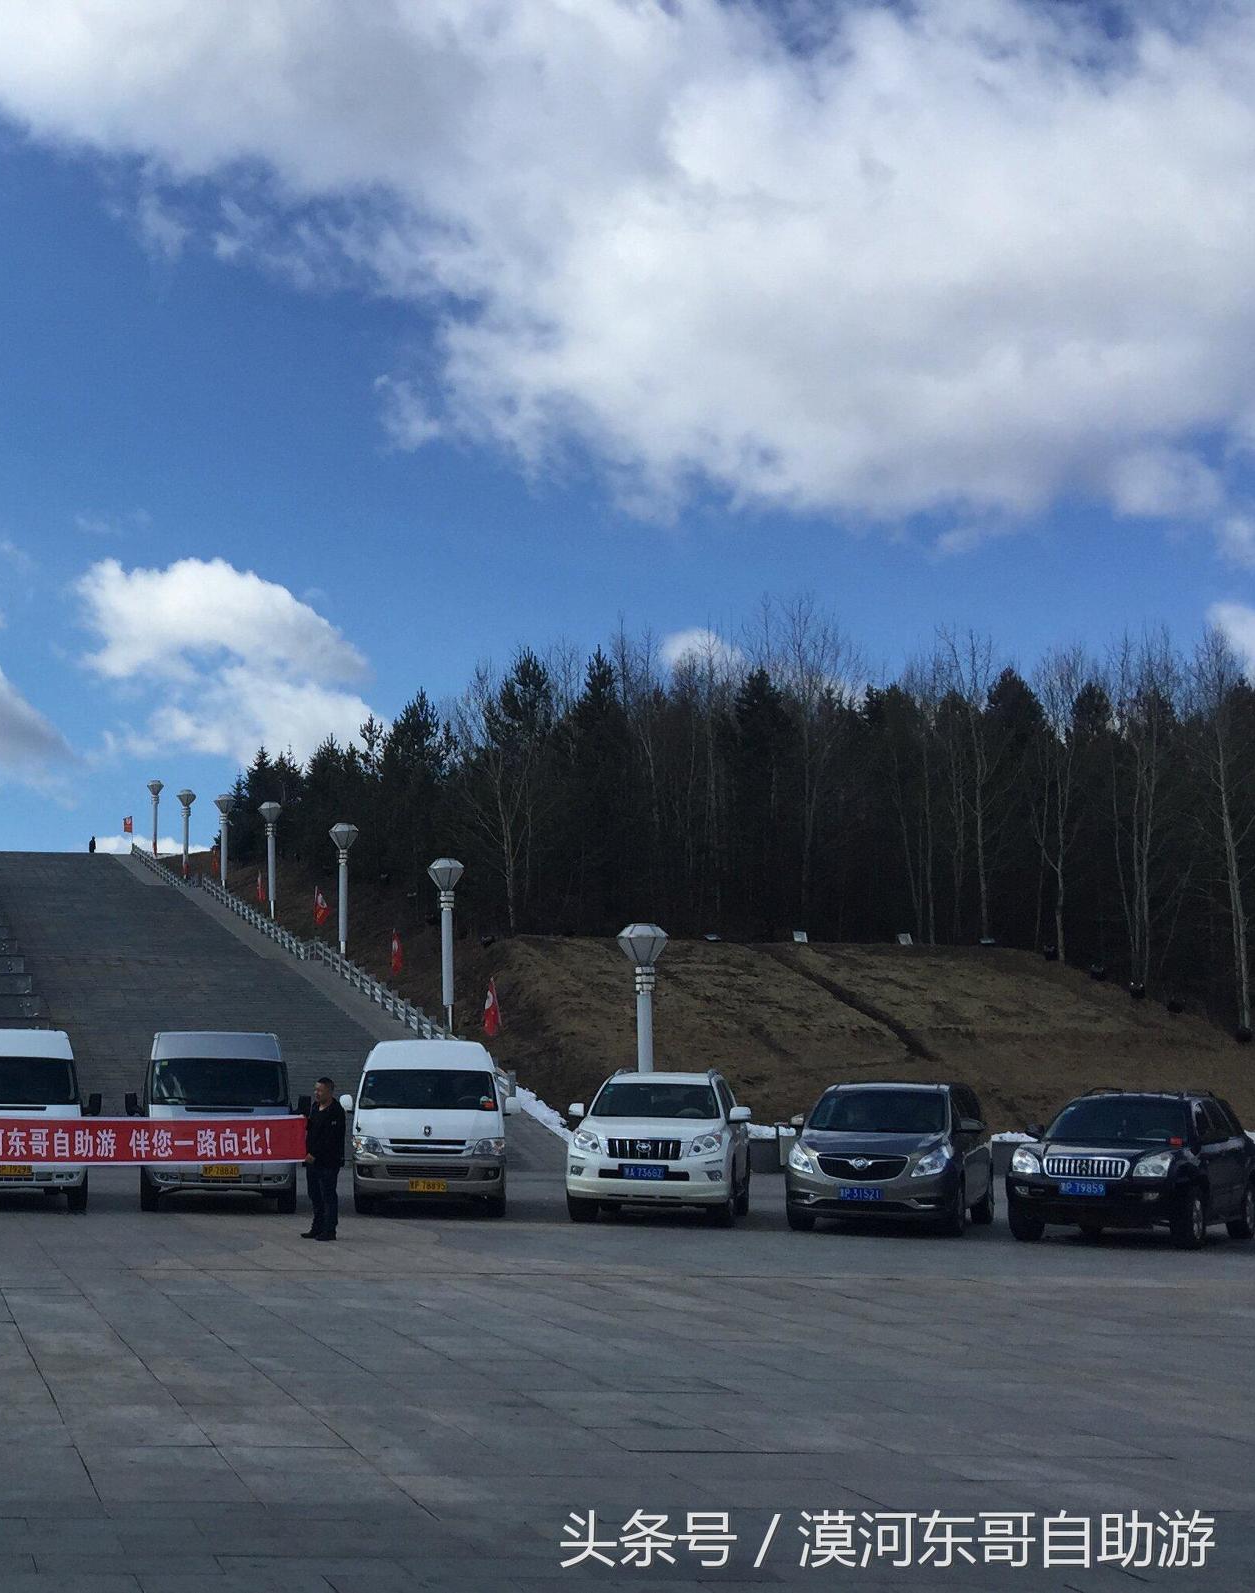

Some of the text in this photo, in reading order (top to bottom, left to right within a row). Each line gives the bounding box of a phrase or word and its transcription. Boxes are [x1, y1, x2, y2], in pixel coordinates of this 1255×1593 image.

[129, 1127, 272, 1158] 伴您一路向北！
